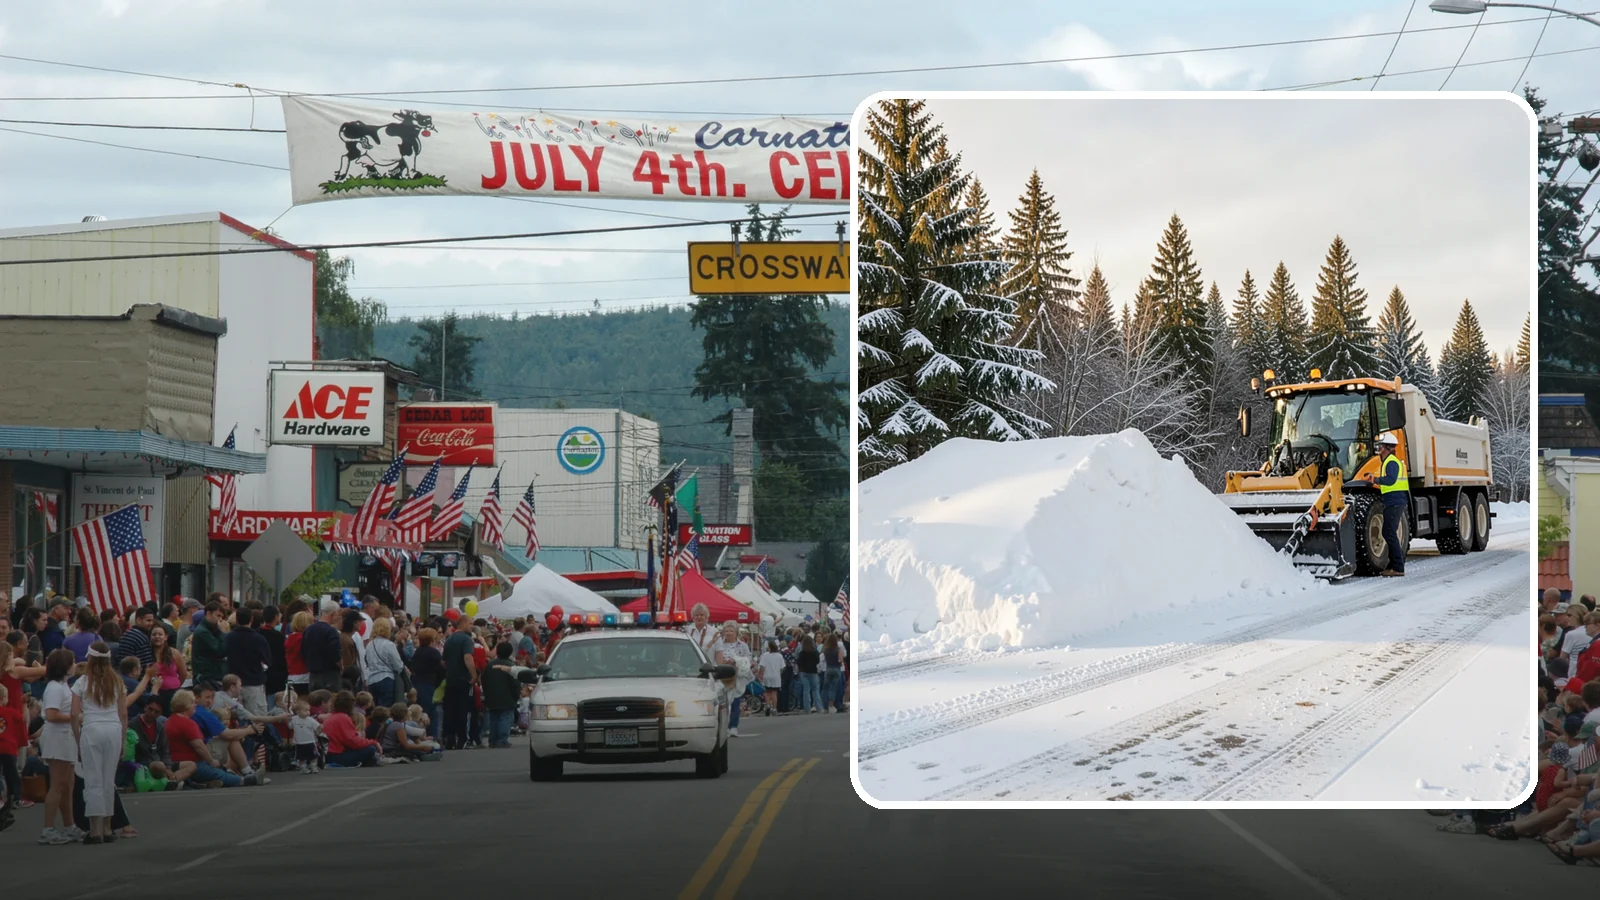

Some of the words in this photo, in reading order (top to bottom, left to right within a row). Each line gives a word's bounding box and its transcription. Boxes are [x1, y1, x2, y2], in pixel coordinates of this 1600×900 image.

[481, 140, 605, 193] JULY
[632, 150, 746, 197] 4th.
[697, 254, 850, 280] CROSSWA
[283, 380, 373, 420] ACE
[406, 409, 452, 421] CEDAR
[284, 421, 370, 436] Hardware
[416, 428, 477, 447] Coca-Cola
[354, 467, 384, 480] Simpl
[96, 485, 124, 495] Vincent
[126, 486, 136, 495] de
[137, 486, 155, 495] Paul
[688, 526, 741, 535] CRNATION
